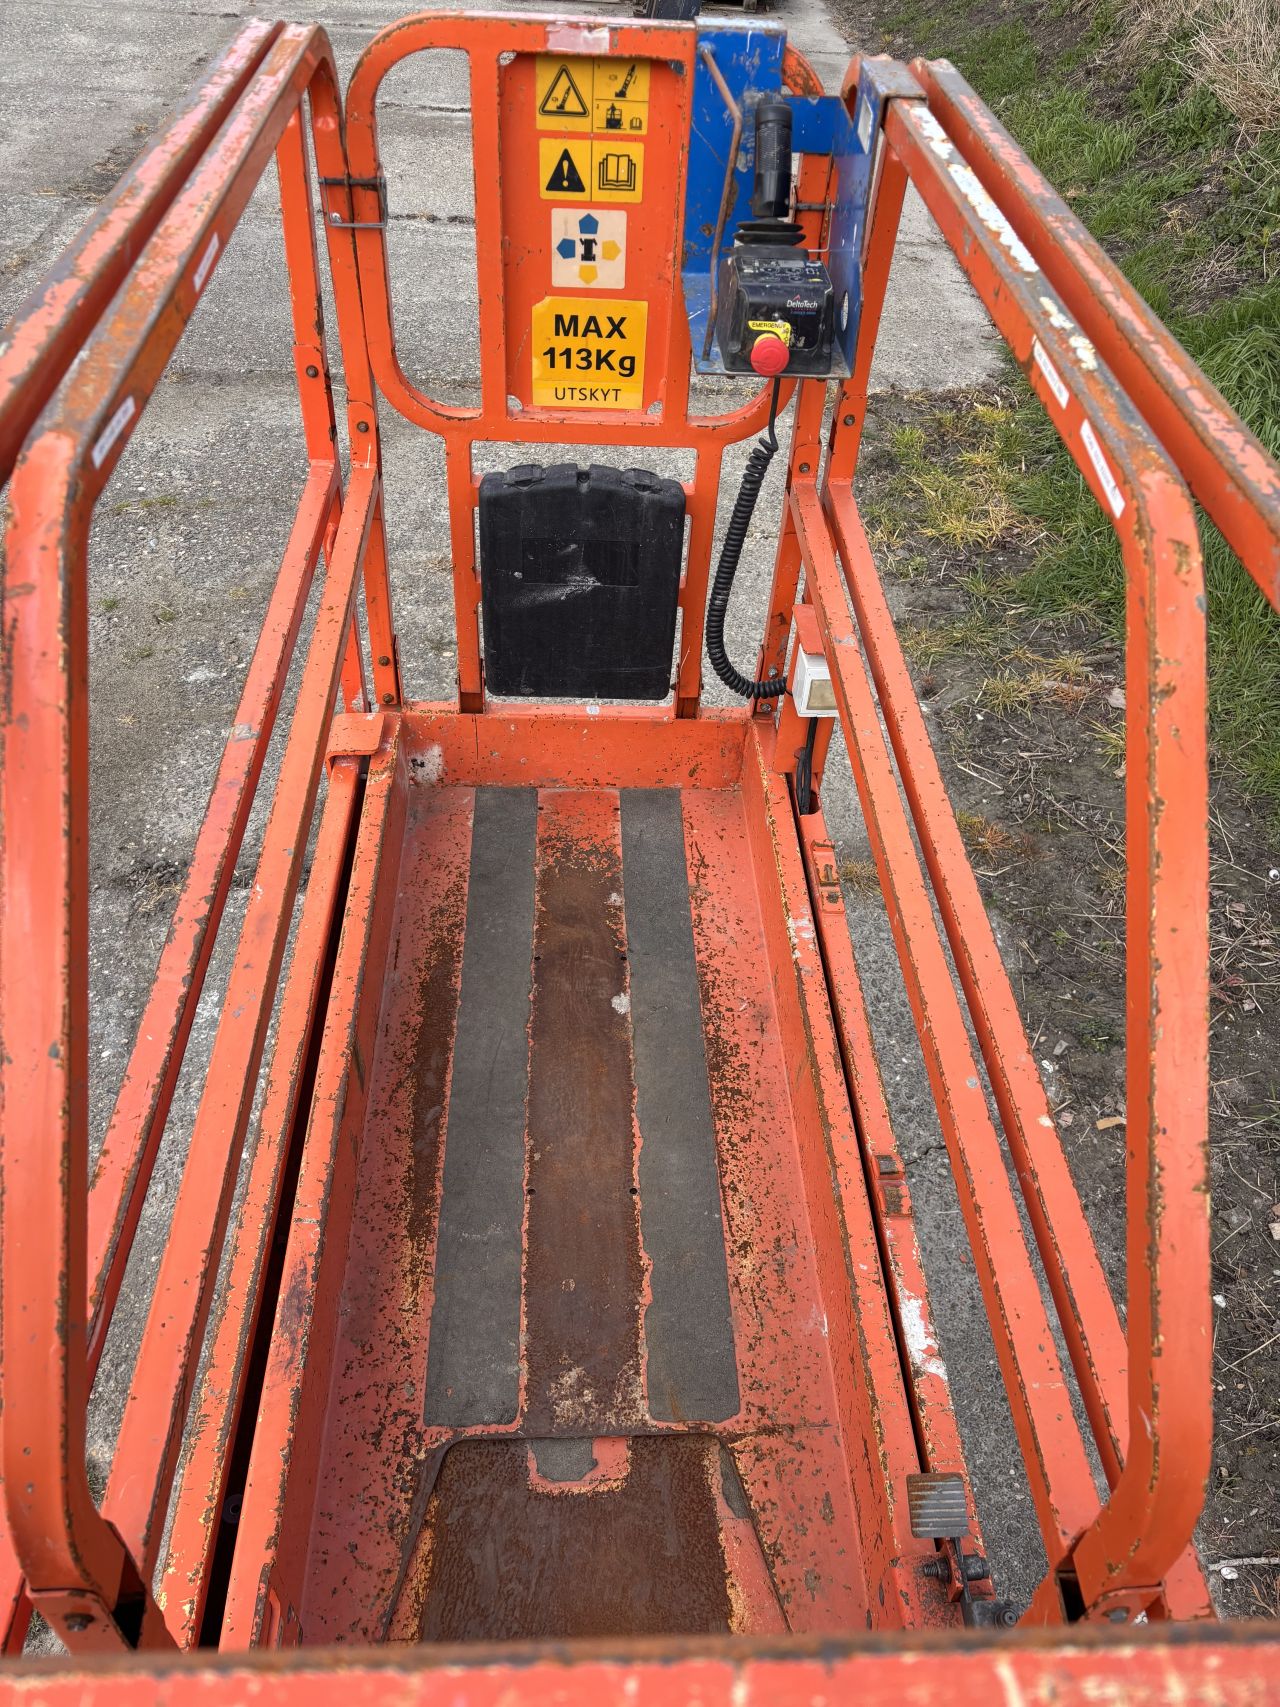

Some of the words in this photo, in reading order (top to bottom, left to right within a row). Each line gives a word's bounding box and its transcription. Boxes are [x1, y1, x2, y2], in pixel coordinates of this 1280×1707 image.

[787, 300, 818, 309] DeltaTech
[554, 313, 628, 340] MAX
[542, 346, 636, 378] 113Kg
[554, 386, 622, 402] UTSKYT
